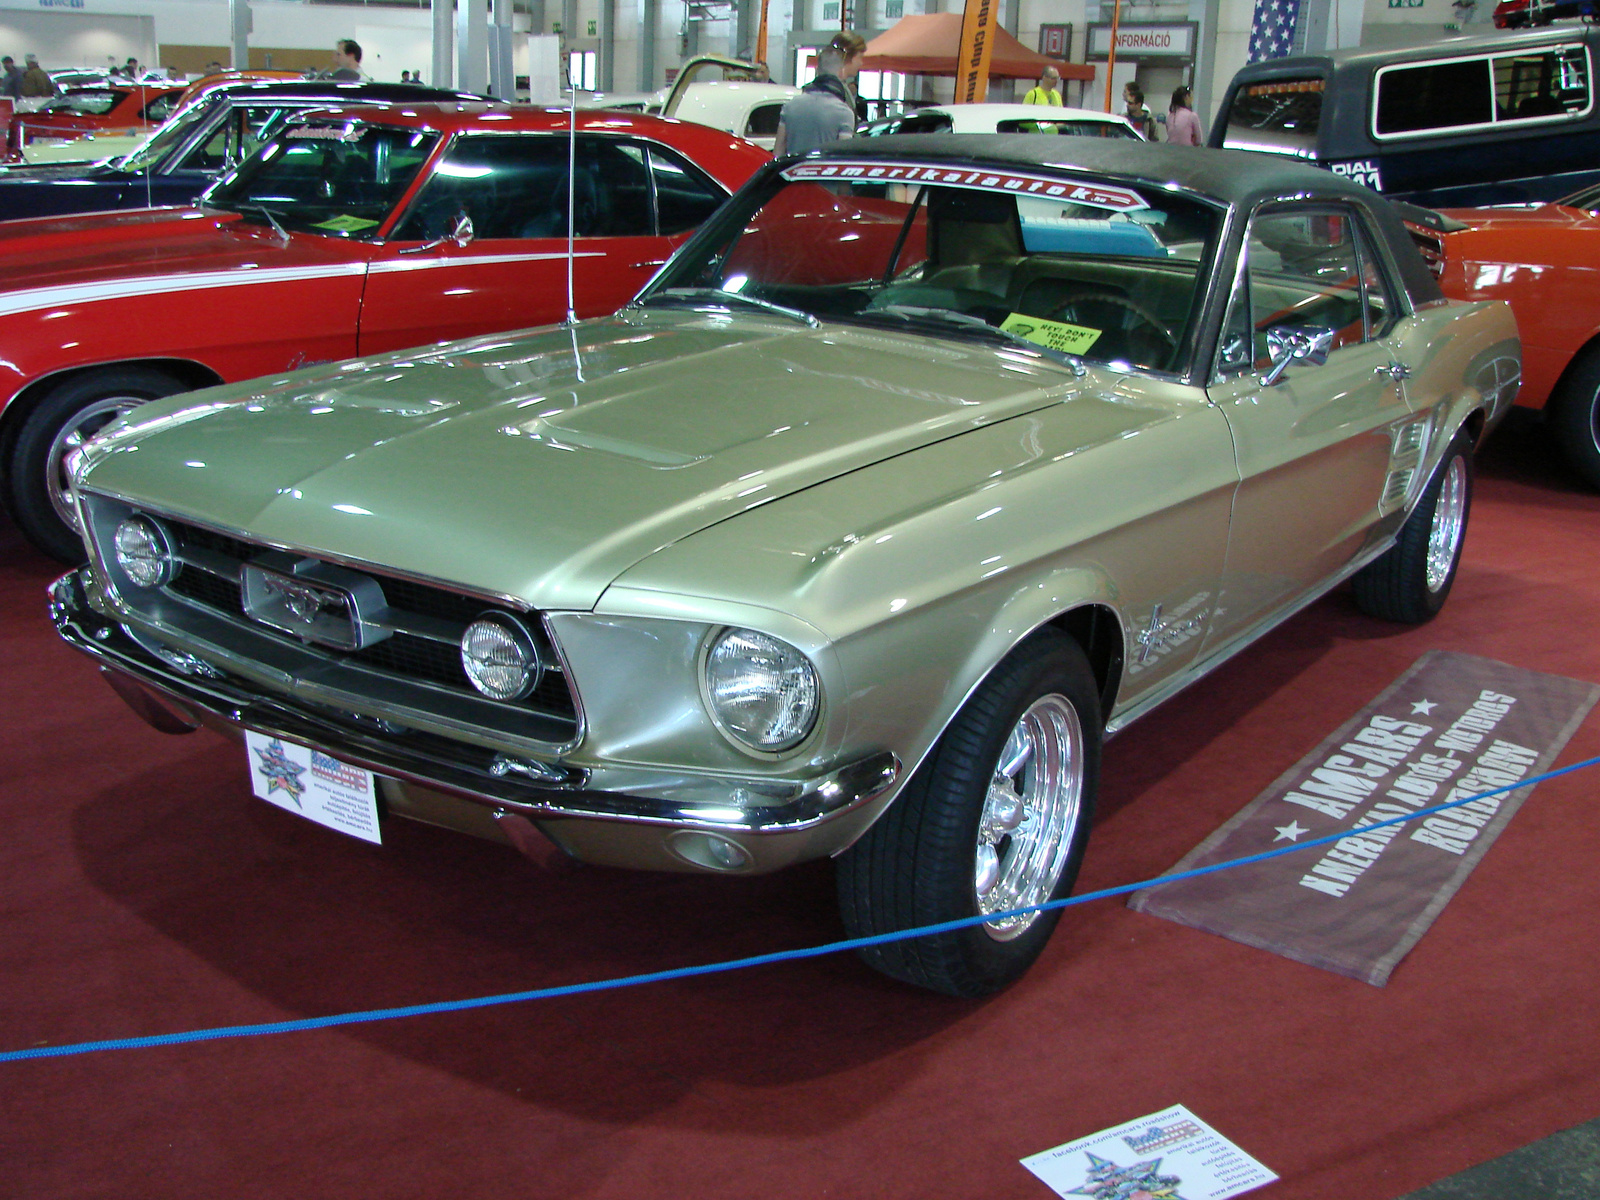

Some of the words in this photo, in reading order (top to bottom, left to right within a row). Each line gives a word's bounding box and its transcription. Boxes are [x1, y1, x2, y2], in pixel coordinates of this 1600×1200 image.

[1113, 31, 1171, 48] NFORMÁCIÓ
[1331, 161, 1379, 176] DIAL
[820, 166, 1107, 204] amerikaiautok.hu
[1344, 172, 1382, 191] 11
[1040, 324, 1062, 332] HEY!
[1065, 329, 1094, 339] DON'T
[1046, 332, 1079, 343] TOUCH
[1048, 339, 1066, 347] THE
[1283, 714, 1434, 820] AMCARS
[1410, 738, 1540, 856] ROADSHOW
